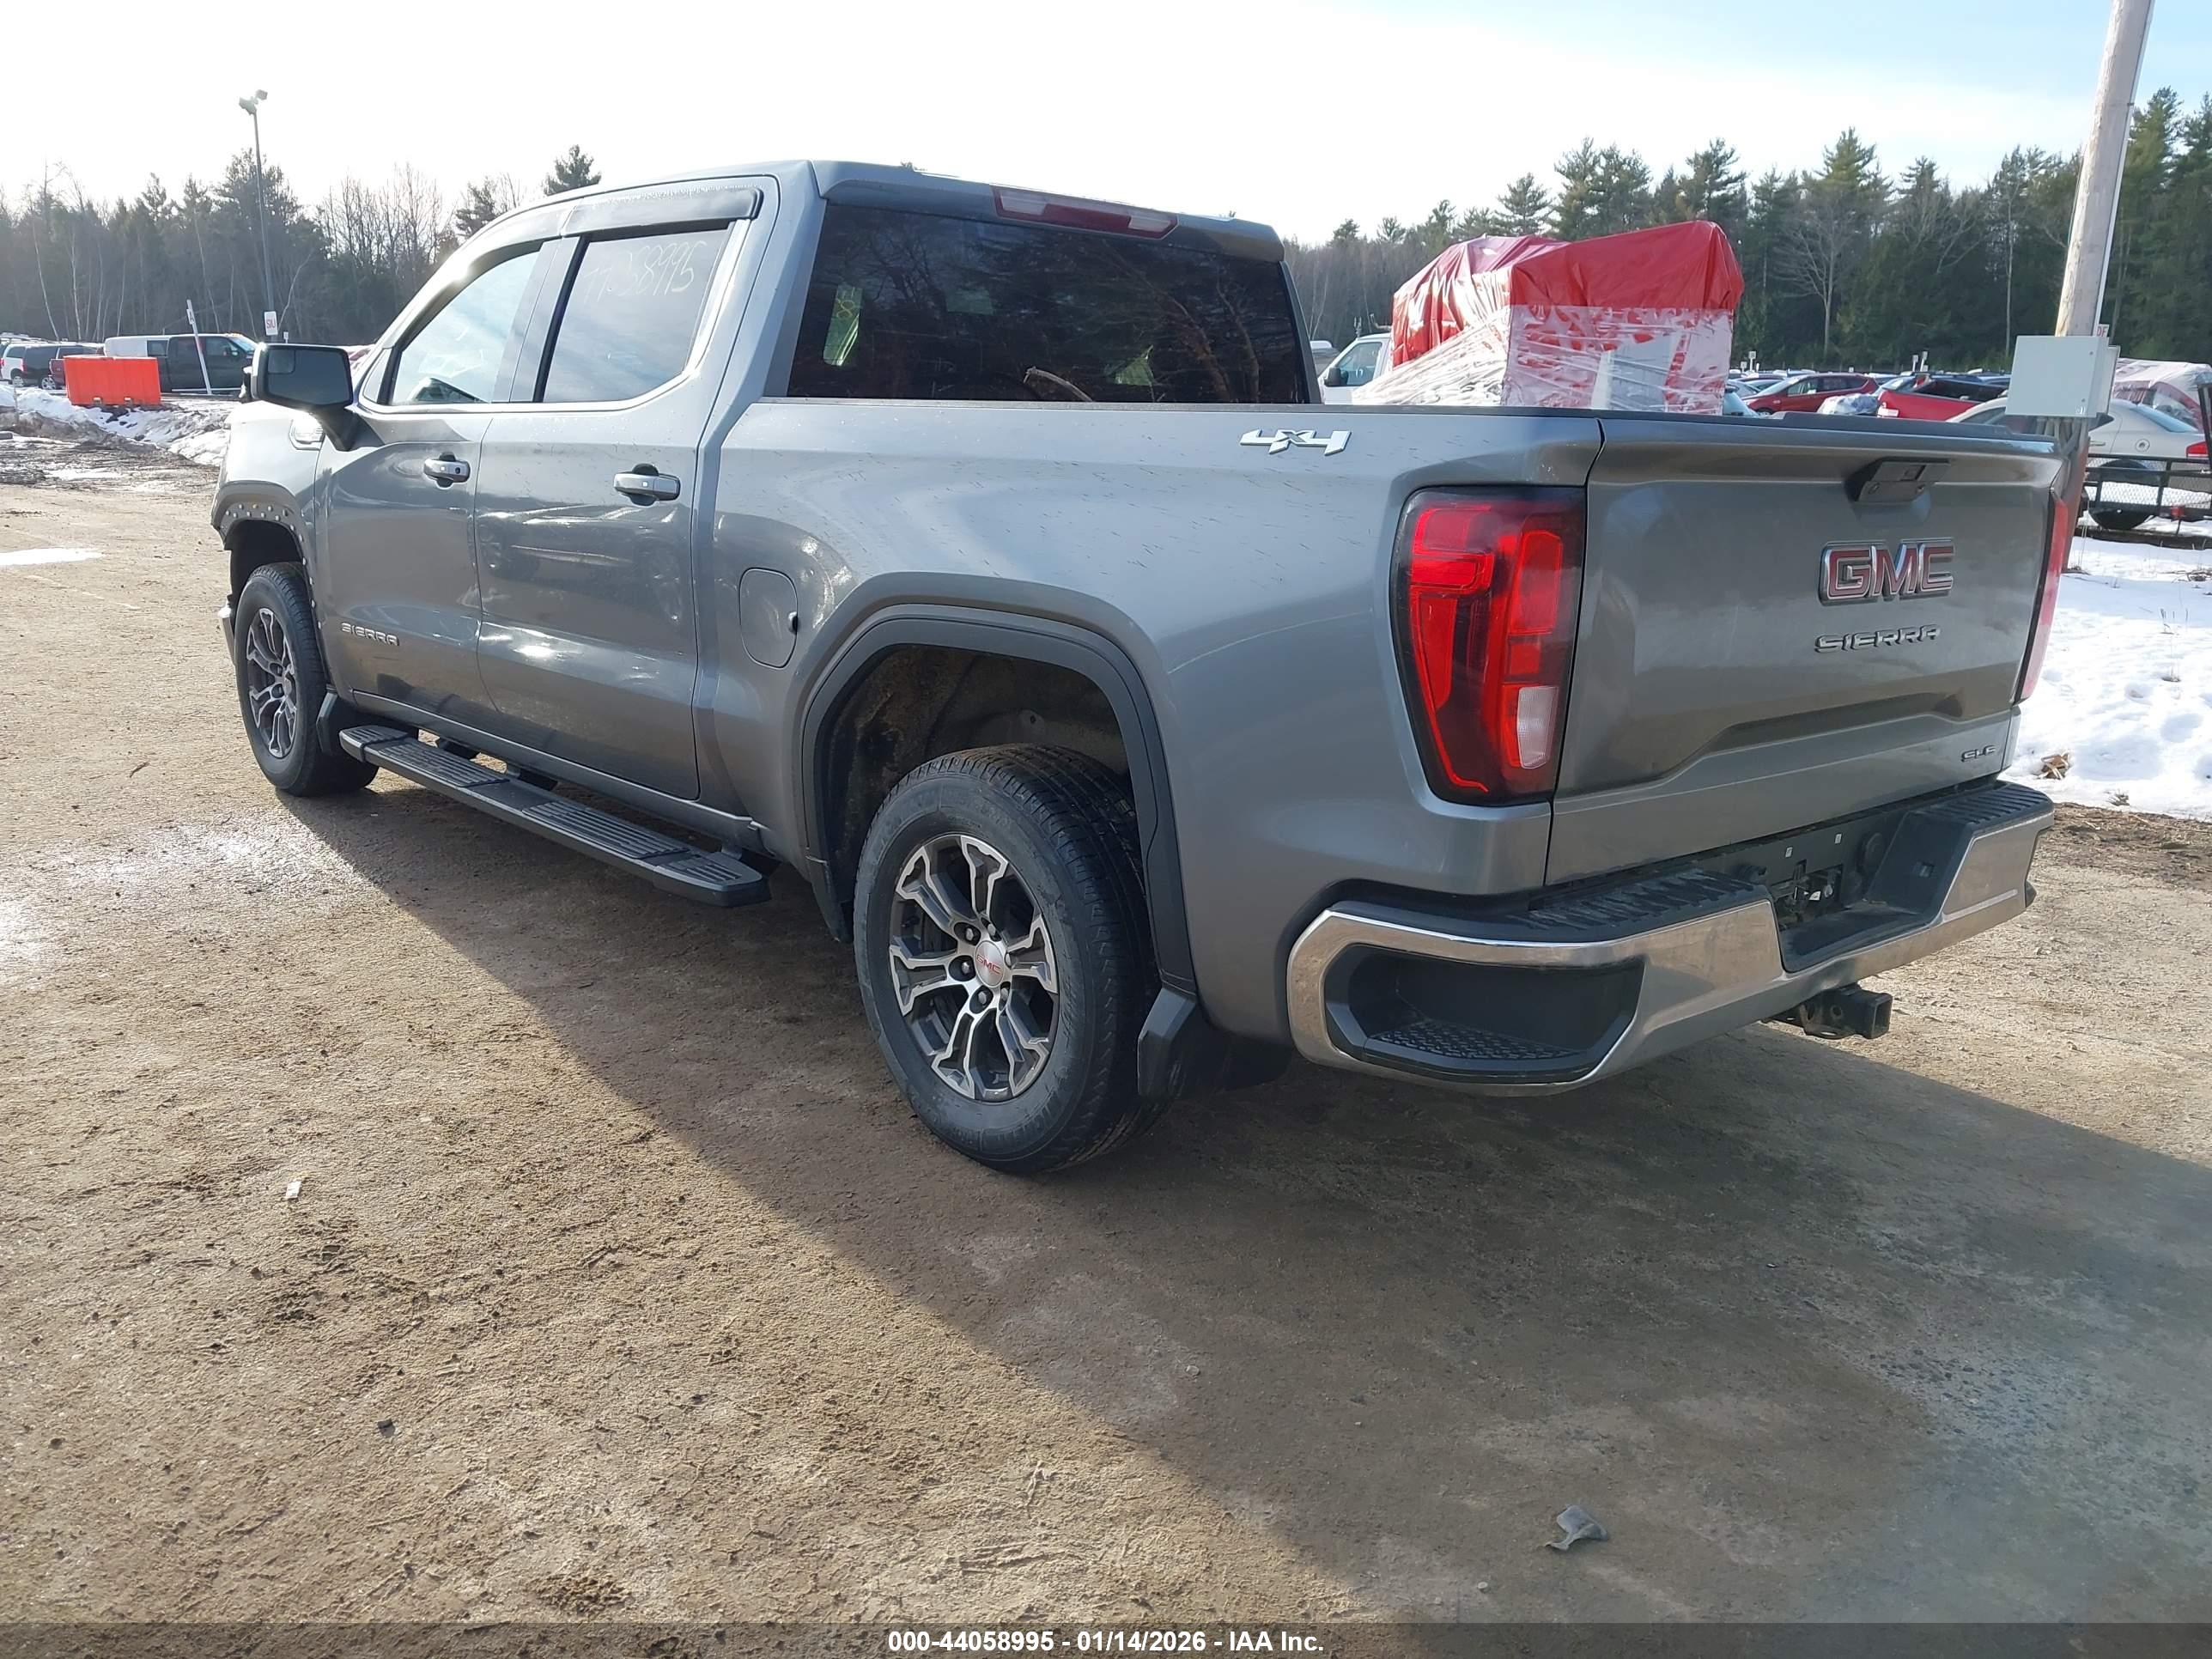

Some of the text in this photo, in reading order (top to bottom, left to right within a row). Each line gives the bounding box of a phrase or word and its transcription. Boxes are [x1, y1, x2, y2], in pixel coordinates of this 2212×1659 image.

[1819, 538, 1955, 606] GMC
[341, 621, 400, 647] SIERRA
[1814, 624, 1942, 653] SIERRA
[975, 953, 1002, 975] GMC
